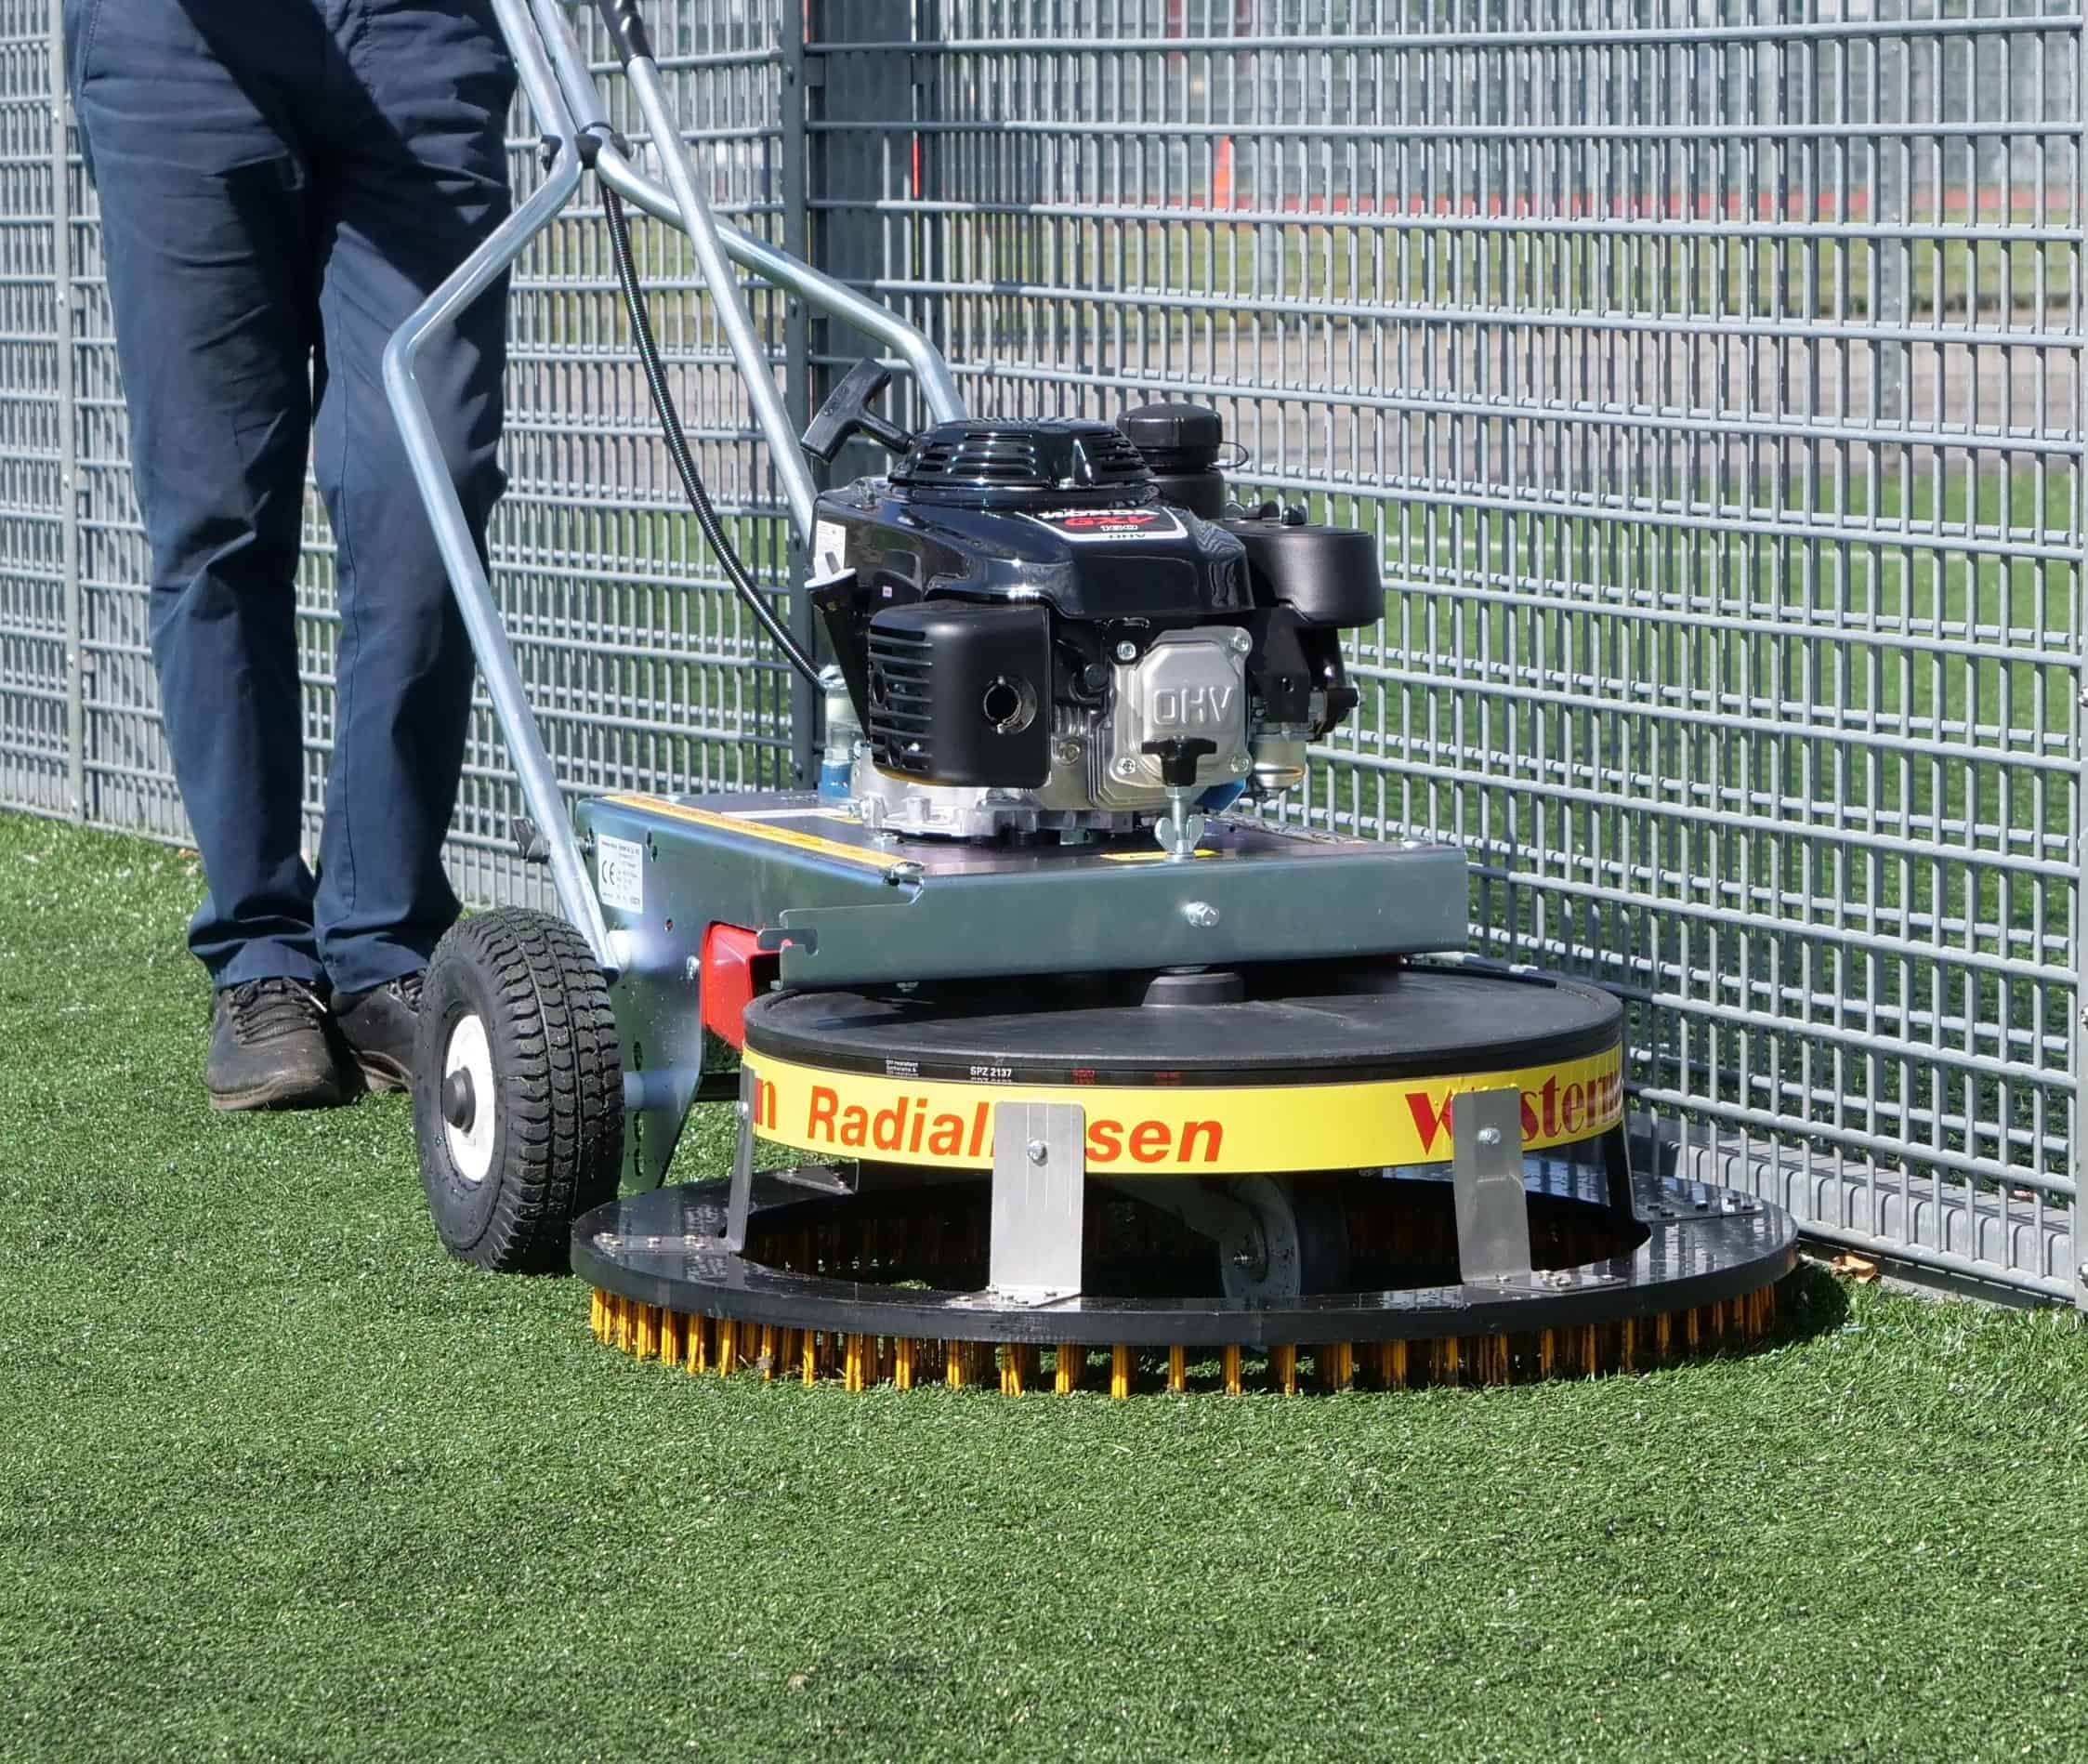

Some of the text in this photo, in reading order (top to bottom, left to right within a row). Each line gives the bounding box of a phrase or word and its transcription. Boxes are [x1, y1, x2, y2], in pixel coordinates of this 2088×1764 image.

[1064, 515, 1159, 526] GXV
[1152, 686, 1233, 725] OHV
[990, 1067, 1012, 1078] 2137
[808, 1084, 1224, 1164] Radialsen
